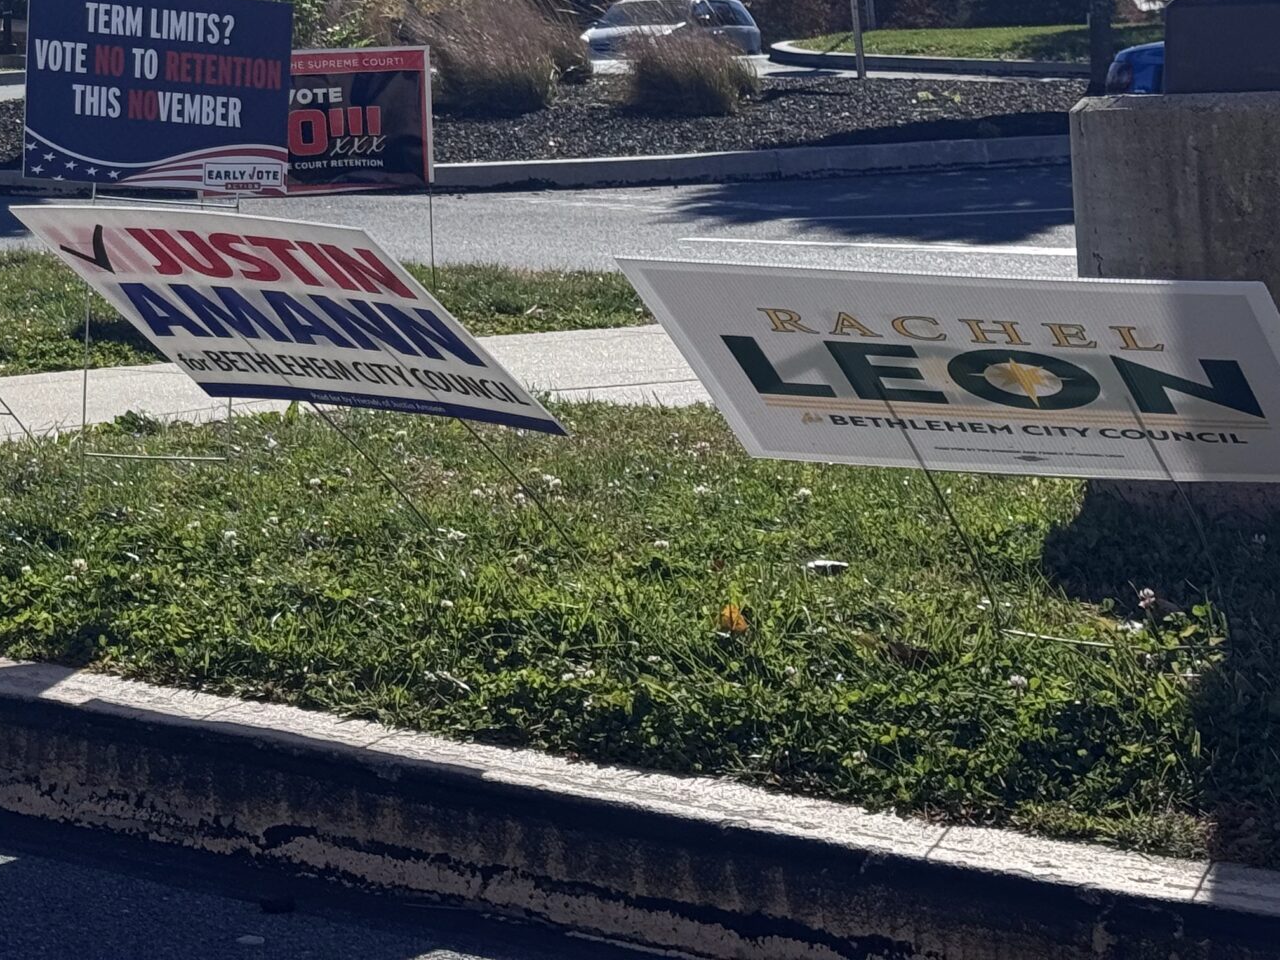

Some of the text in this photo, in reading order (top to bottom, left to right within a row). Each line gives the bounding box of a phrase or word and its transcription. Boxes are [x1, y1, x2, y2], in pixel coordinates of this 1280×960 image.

[85, 2, 235, 45] TERM LIMITS?
[35, 38, 282, 90] VOTE NO TO RETENTION
[308, 59, 360, 69] SUPREME
[362, 57, 404, 66] COURT!
[72, 84, 242, 128] THIS NOVEMBER
[207, 170, 246, 181] EARLY
[294, 160, 328, 170] COURT
[330, 159, 384, 168] RETENTION
[124, 228, 418, 300] JUSTIN
[118, 282, 488, 368] AMANN
[757, 307, 1164, 352] RACHEL
[178, 350, 531, 406] for BETHLEHEM CITY COUNCIL
[720, 334, 1266, 419] LEON
[829, 414, 1248, 445] BETHLEHEM CITY COUNCIL
